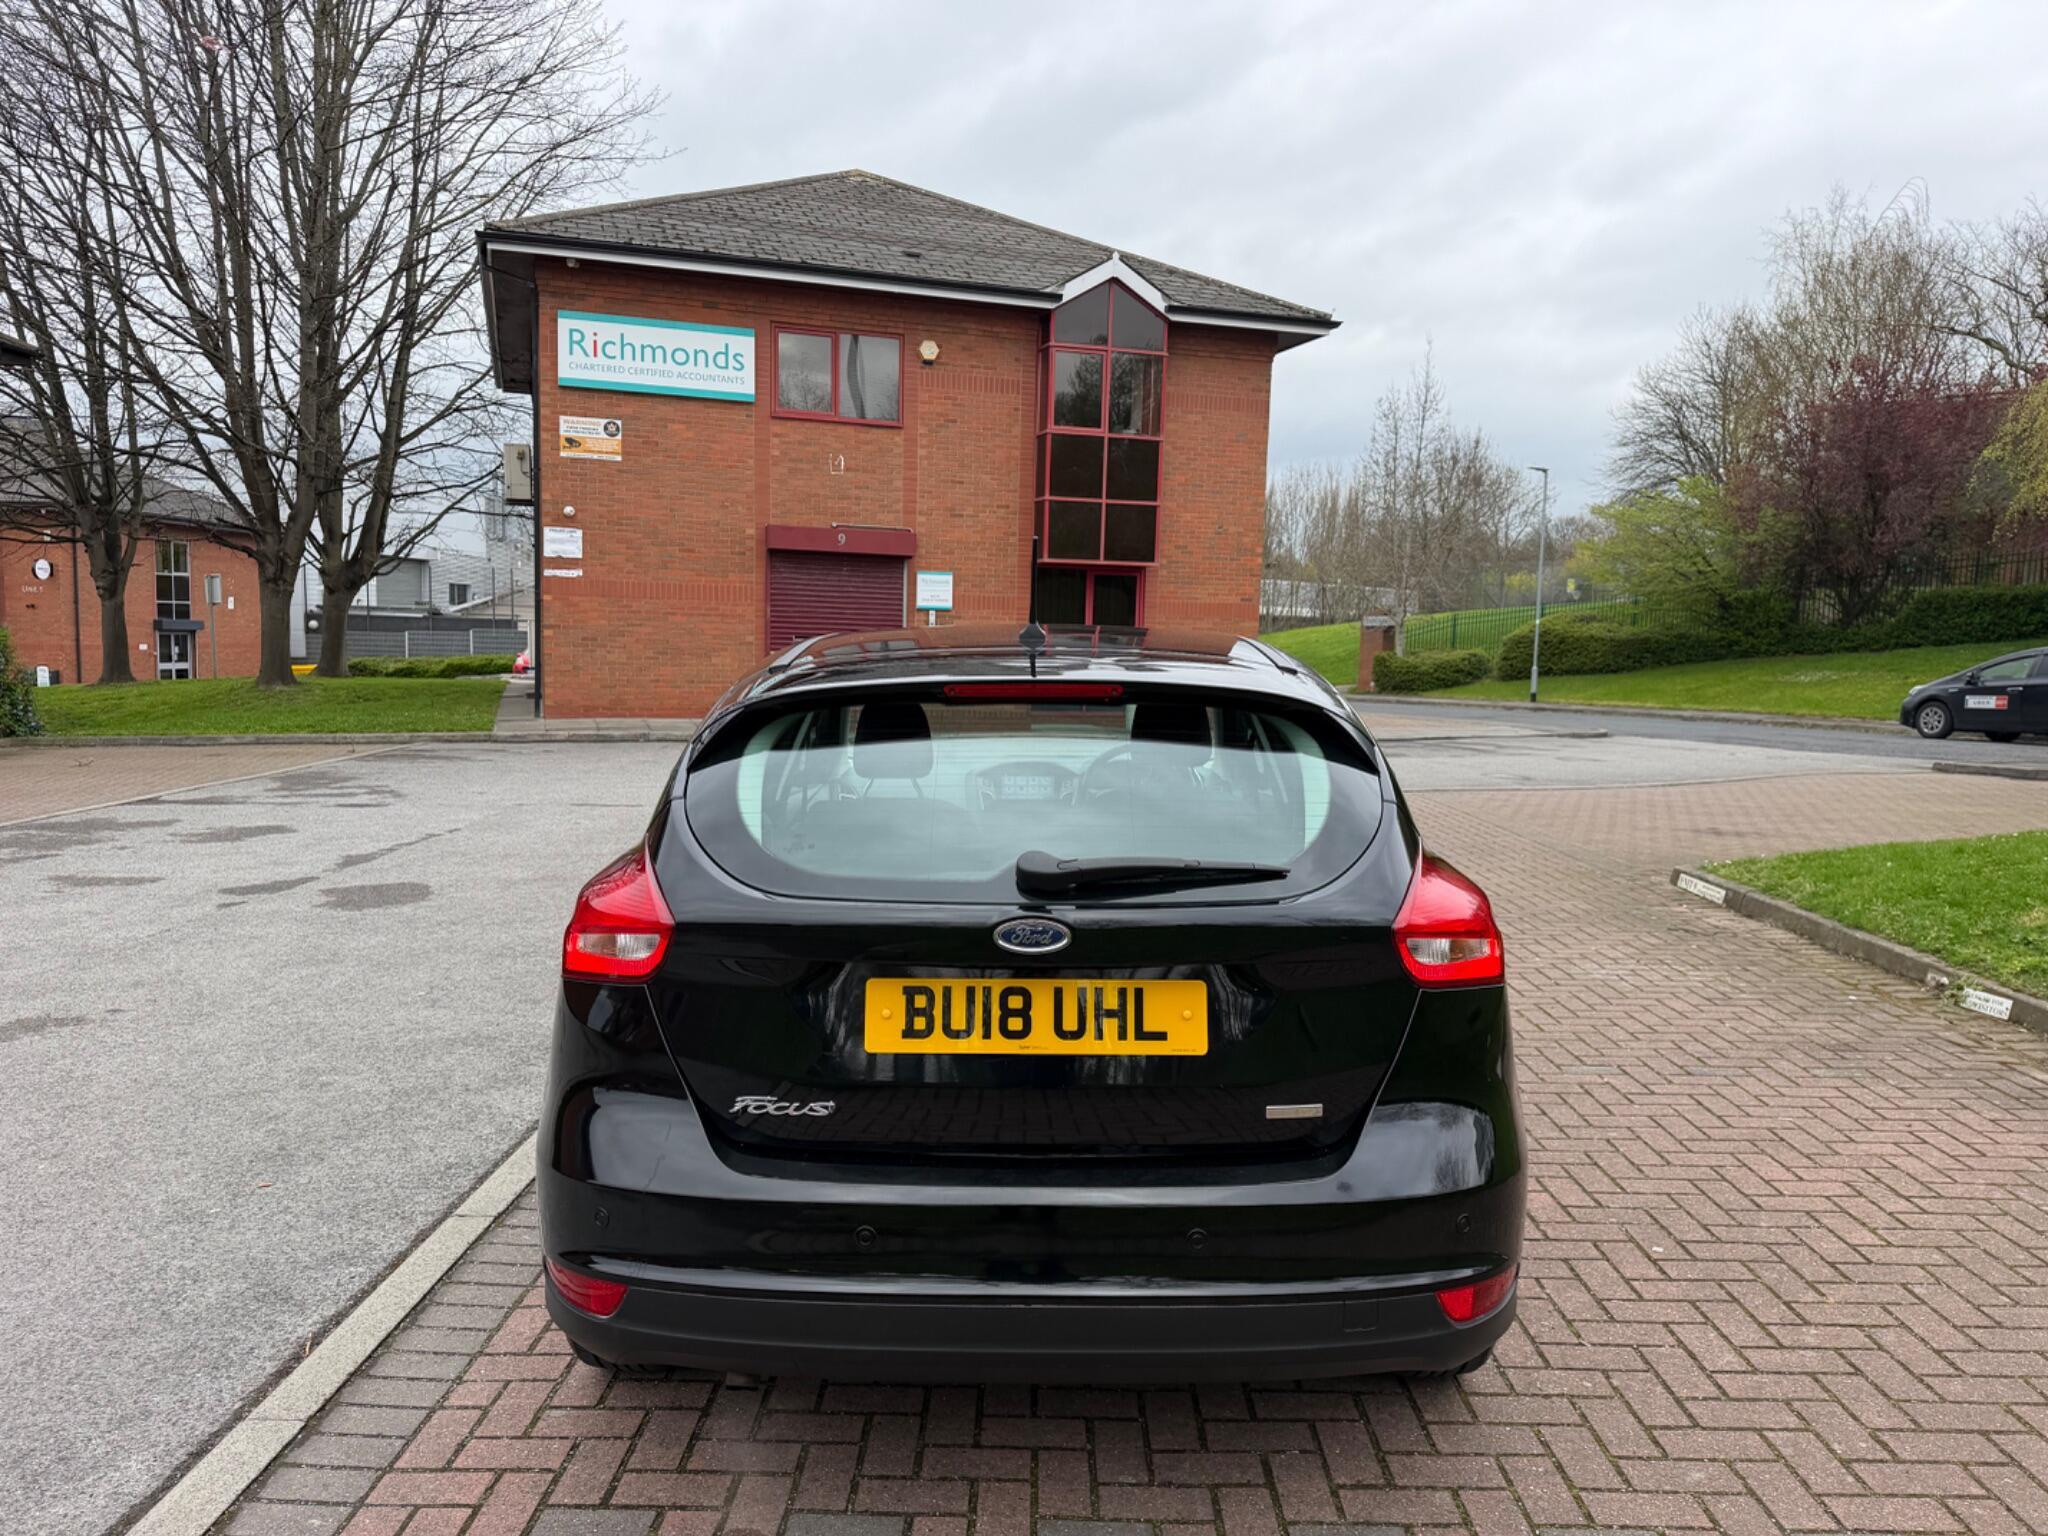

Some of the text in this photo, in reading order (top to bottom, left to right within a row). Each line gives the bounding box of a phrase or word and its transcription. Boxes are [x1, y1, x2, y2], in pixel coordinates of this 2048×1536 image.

[569, 328, 745, 372] Richmonds
[568, 361, 746, 385] CHARTERED CERTIFIED ACCOUNTANTS
[838, 532, 846, 546] 9
[1011, 927, 1054, 945] Ford
[902, 986, 1168, 1041] BU18 UHL
